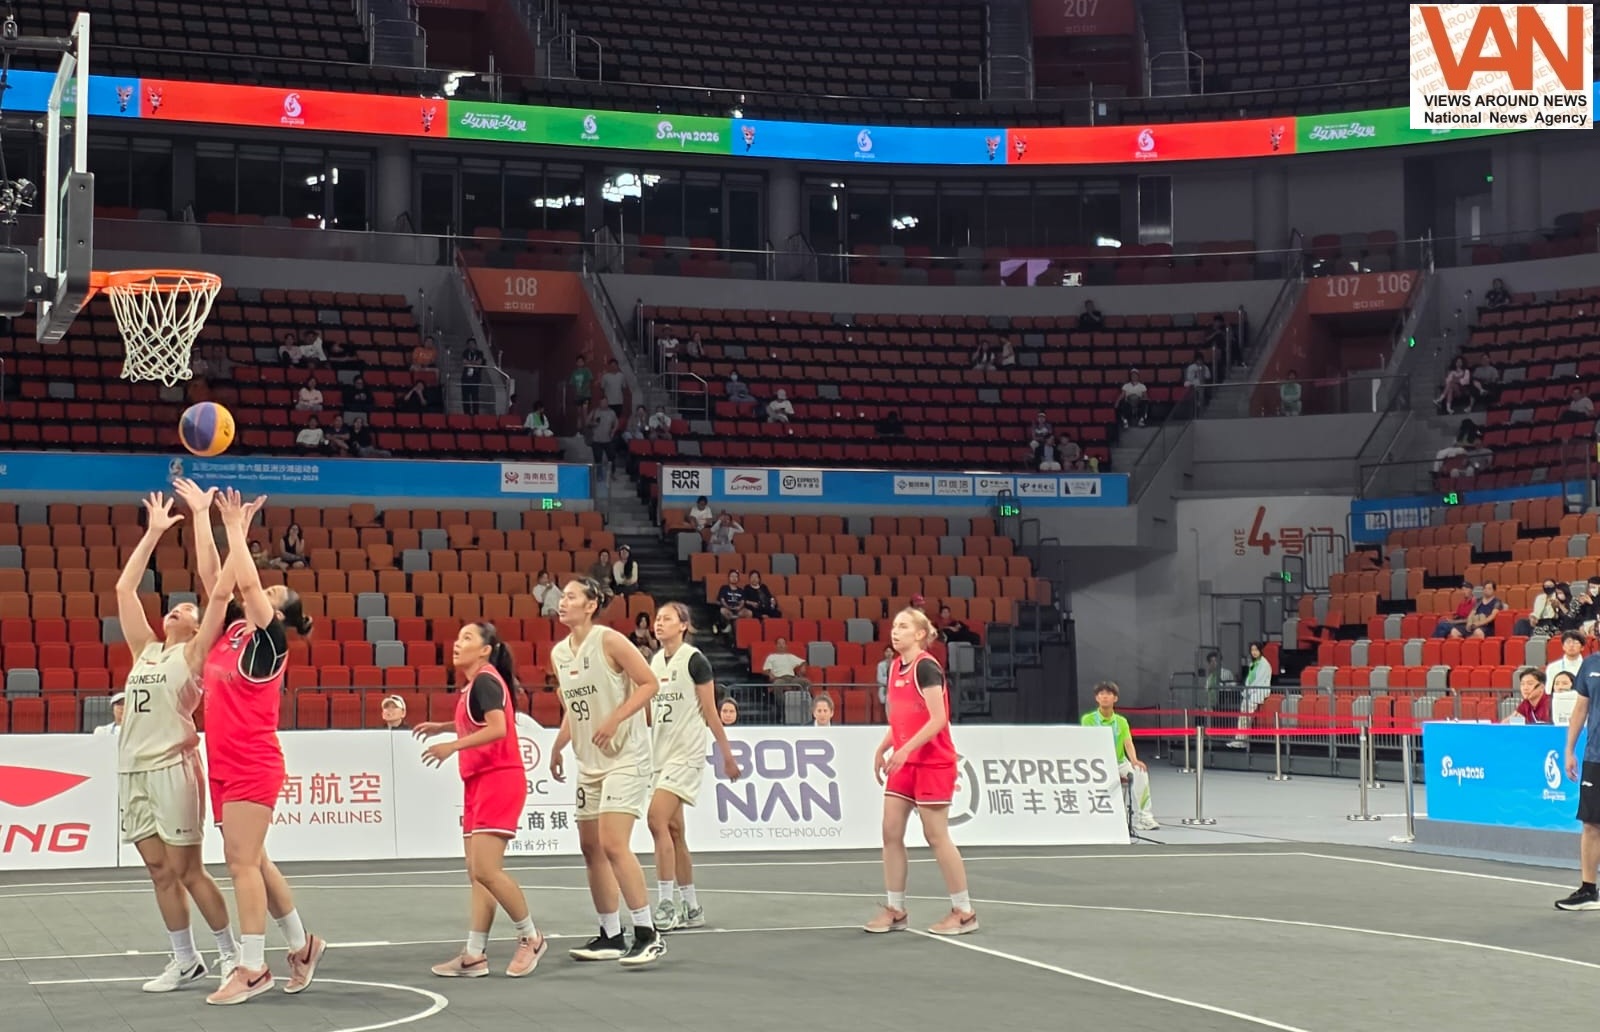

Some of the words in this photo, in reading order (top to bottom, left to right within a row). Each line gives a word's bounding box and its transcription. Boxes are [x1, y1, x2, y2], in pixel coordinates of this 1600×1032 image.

[1064, 0, 1098, 17] 207
[504, 276, 537, 297] 108
[1327, 277, 1360, 297] 107
[1377, 273, 1410, 294] 106
[671, 470, 699, 479] BOR
[672, 480, 699, 489] NAN
[1234, 528, 1245, 556] GATE
[132, 690, 151, 713] 12
[571, 700, 590, 721] 99
[705, 740, 836, 780] BOR
[982, 759, 1108, 785] EXPRESS
[716, 781, 842, 823] NAN
[987, 789, 1114, 815] 顺丰速运
[270, 811, 301, 825] AN
[309, 810, 382, 825] AIRLINES
[0, 823, 91, 853] NG
[720, 829, 764, 839] SPORTS
[768, 827, 842, 838] TECHNOLOGY
